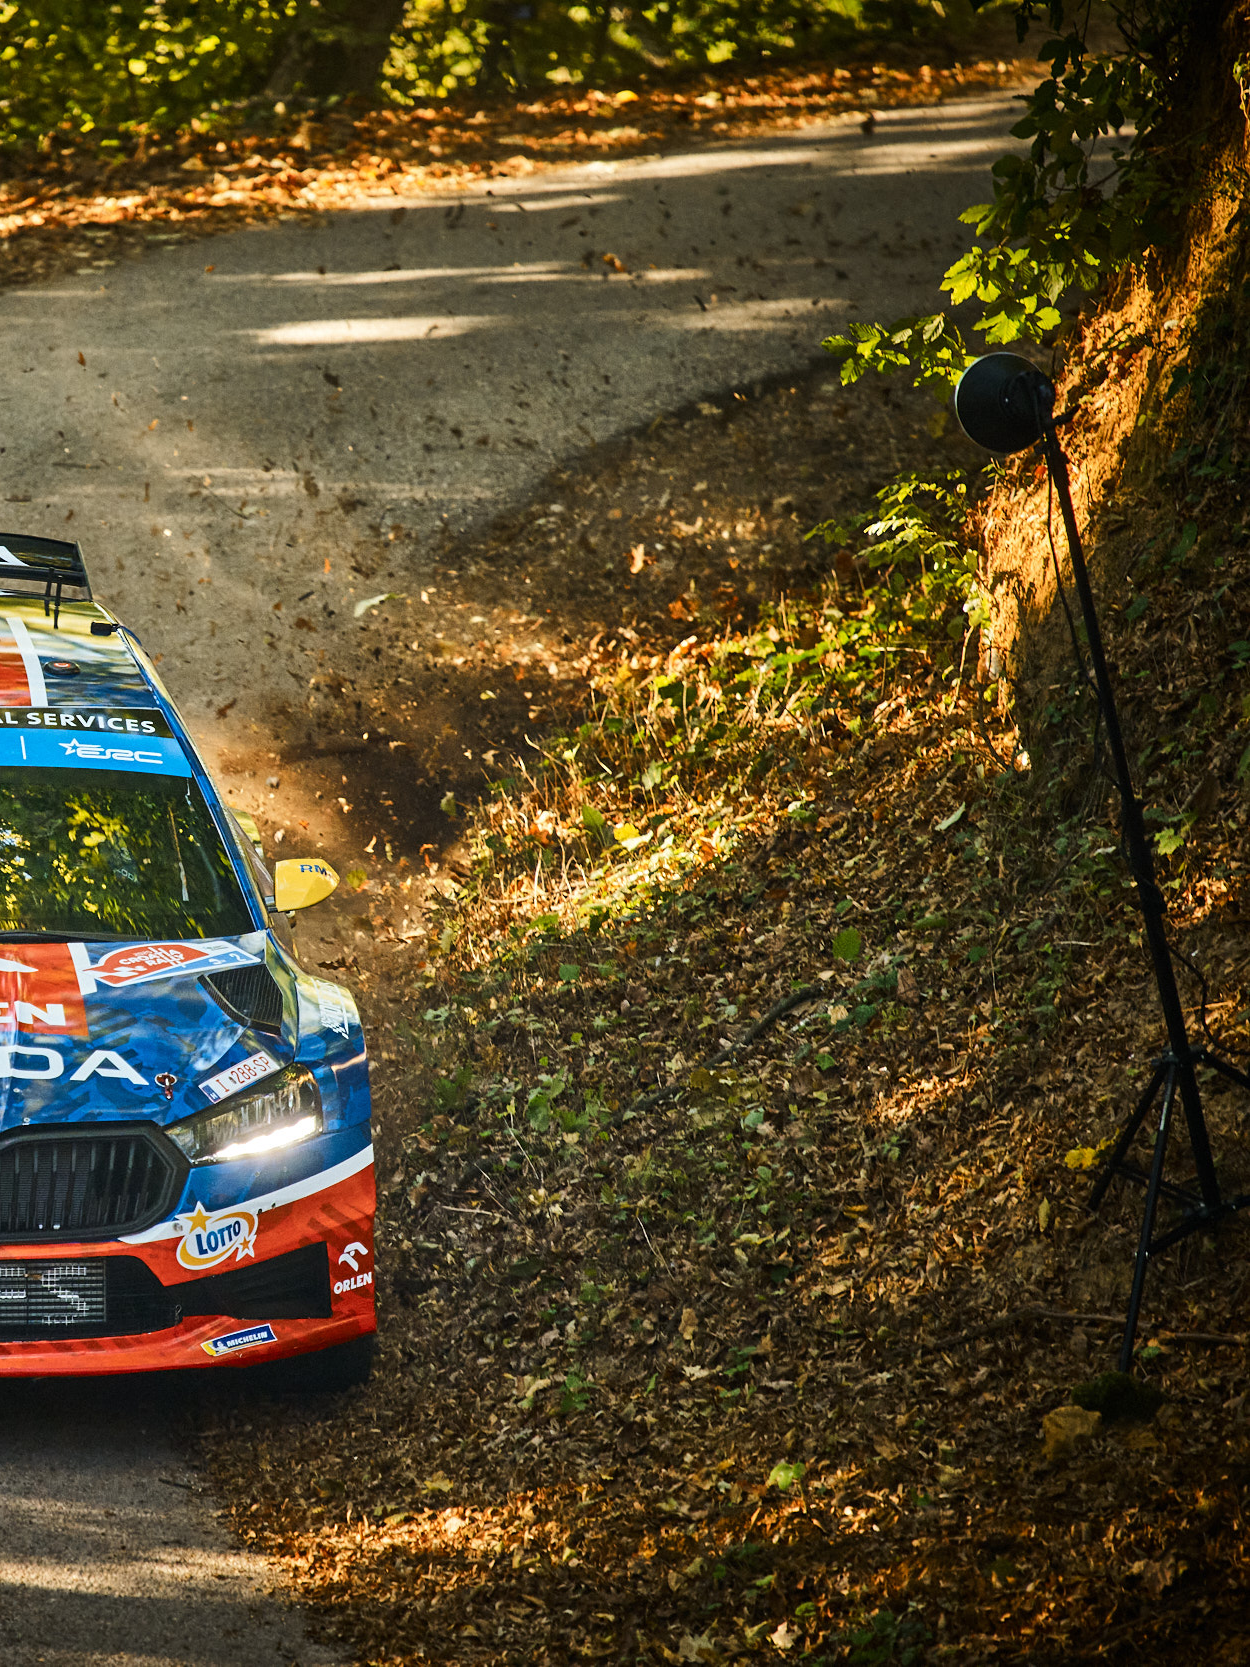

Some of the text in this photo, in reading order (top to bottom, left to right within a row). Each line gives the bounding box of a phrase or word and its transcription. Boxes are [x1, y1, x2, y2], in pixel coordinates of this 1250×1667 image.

[26, 712, 156, 734] SERVICES
[76, 743, 163, 765] ERC
[300, 864, 332, 877] RM
[119, 949, 181, 965] CROATIA
[195, 1220, 241, 1255] LOTTO
[333, 1271, 373, 1295] ORLEN
[226, 1331, 268, 1348] MICHELIN
